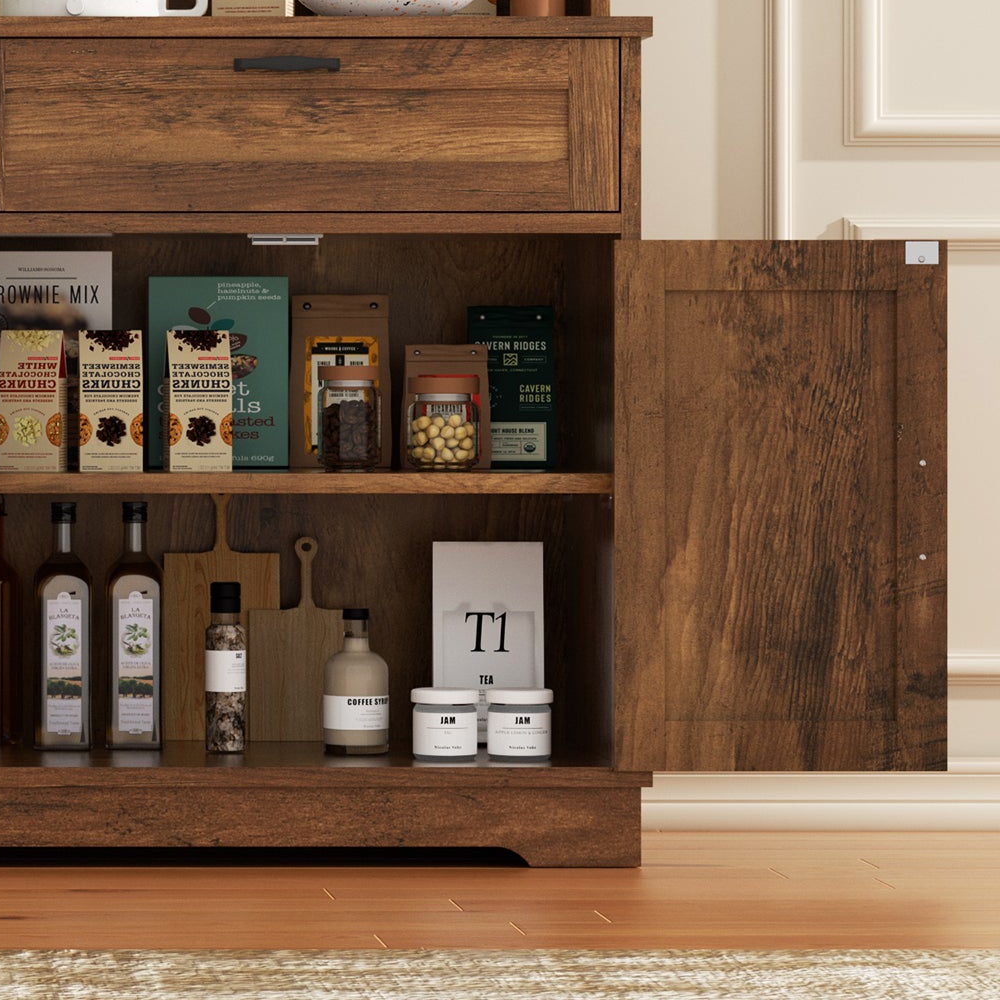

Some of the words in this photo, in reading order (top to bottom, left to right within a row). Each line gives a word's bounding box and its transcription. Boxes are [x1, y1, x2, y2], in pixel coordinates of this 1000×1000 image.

[70, 285, 99, 304] MIX
[514, 341, 547, 350] RIDGES
[519, 384, 550, 393] CAVERN
[519, 394, 551, 402] RIDGES
[465, 612, 510, 653] T1
[479, 675, 494, 685] TEA
[440, 716, 456, 725] JAM
[515, 716, 531, 725] JAM
